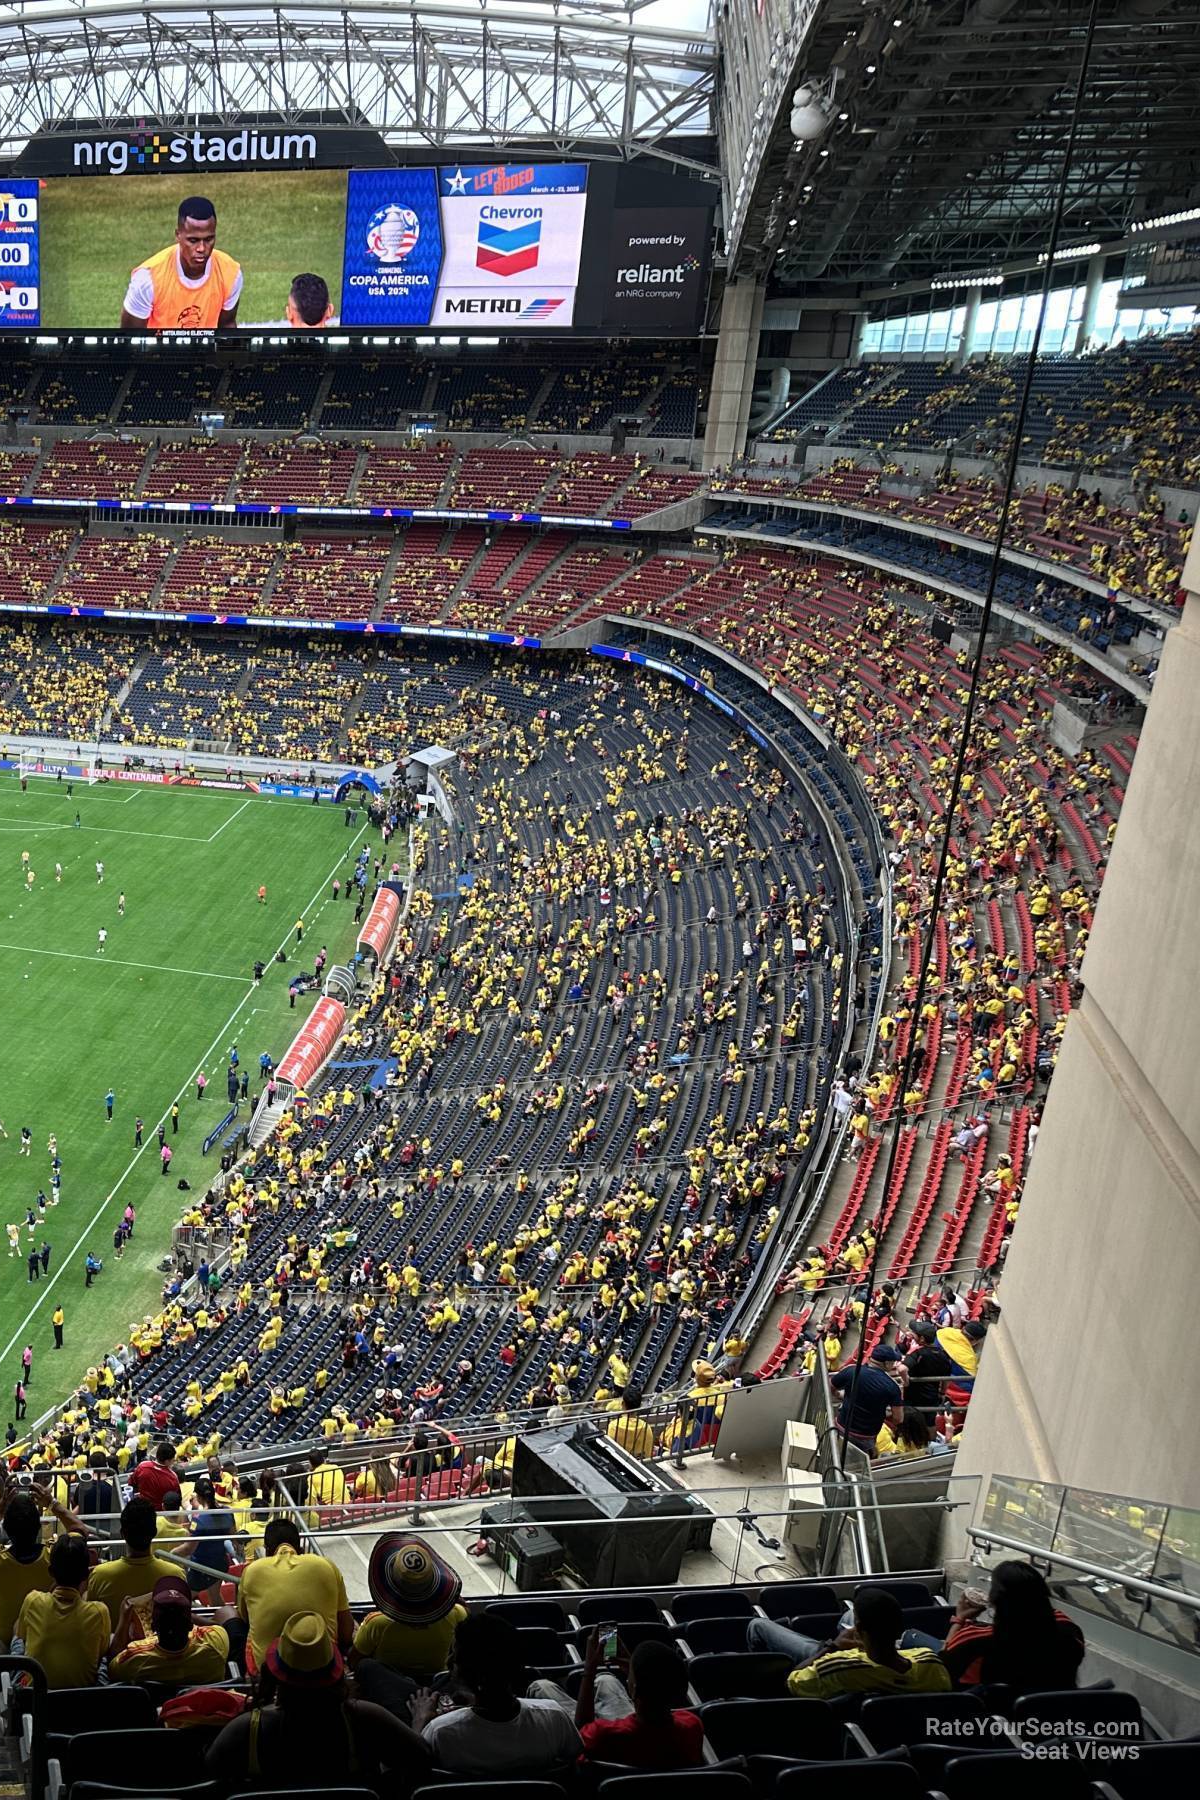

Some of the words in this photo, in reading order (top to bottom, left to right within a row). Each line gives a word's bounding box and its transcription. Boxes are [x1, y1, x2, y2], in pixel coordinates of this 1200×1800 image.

[73, 141, 128, 174] nrg
[169, 130, 316, 163] stadium
[474, 166, 506, 191] LET'S
[493, 167, 535, 195] RODEO
[18, 203, 28, 218] 0
[479, 205, 543, 220] Chevron
[629, 235, 671, 247] powered
[673, 235, 686, 247] by
[350, 275, 379, 286] COPA
[380, 275, 429, 286] AMERICA
[617, 264, 684, 283] reliant
[368, 287, 386, 296] USA
[388, 287, 409, 296] 2024
[615, 290, 624, 298] an
[626, 289, 643, 298] NRG
[644, 290, 682, 300] company
[19, 292, 29, 306] 0
[445, 298, 521, 314] METRO
[43, 763, 68, 774] ULTRA
[118, 770, 164, 783] CENTENARIO
